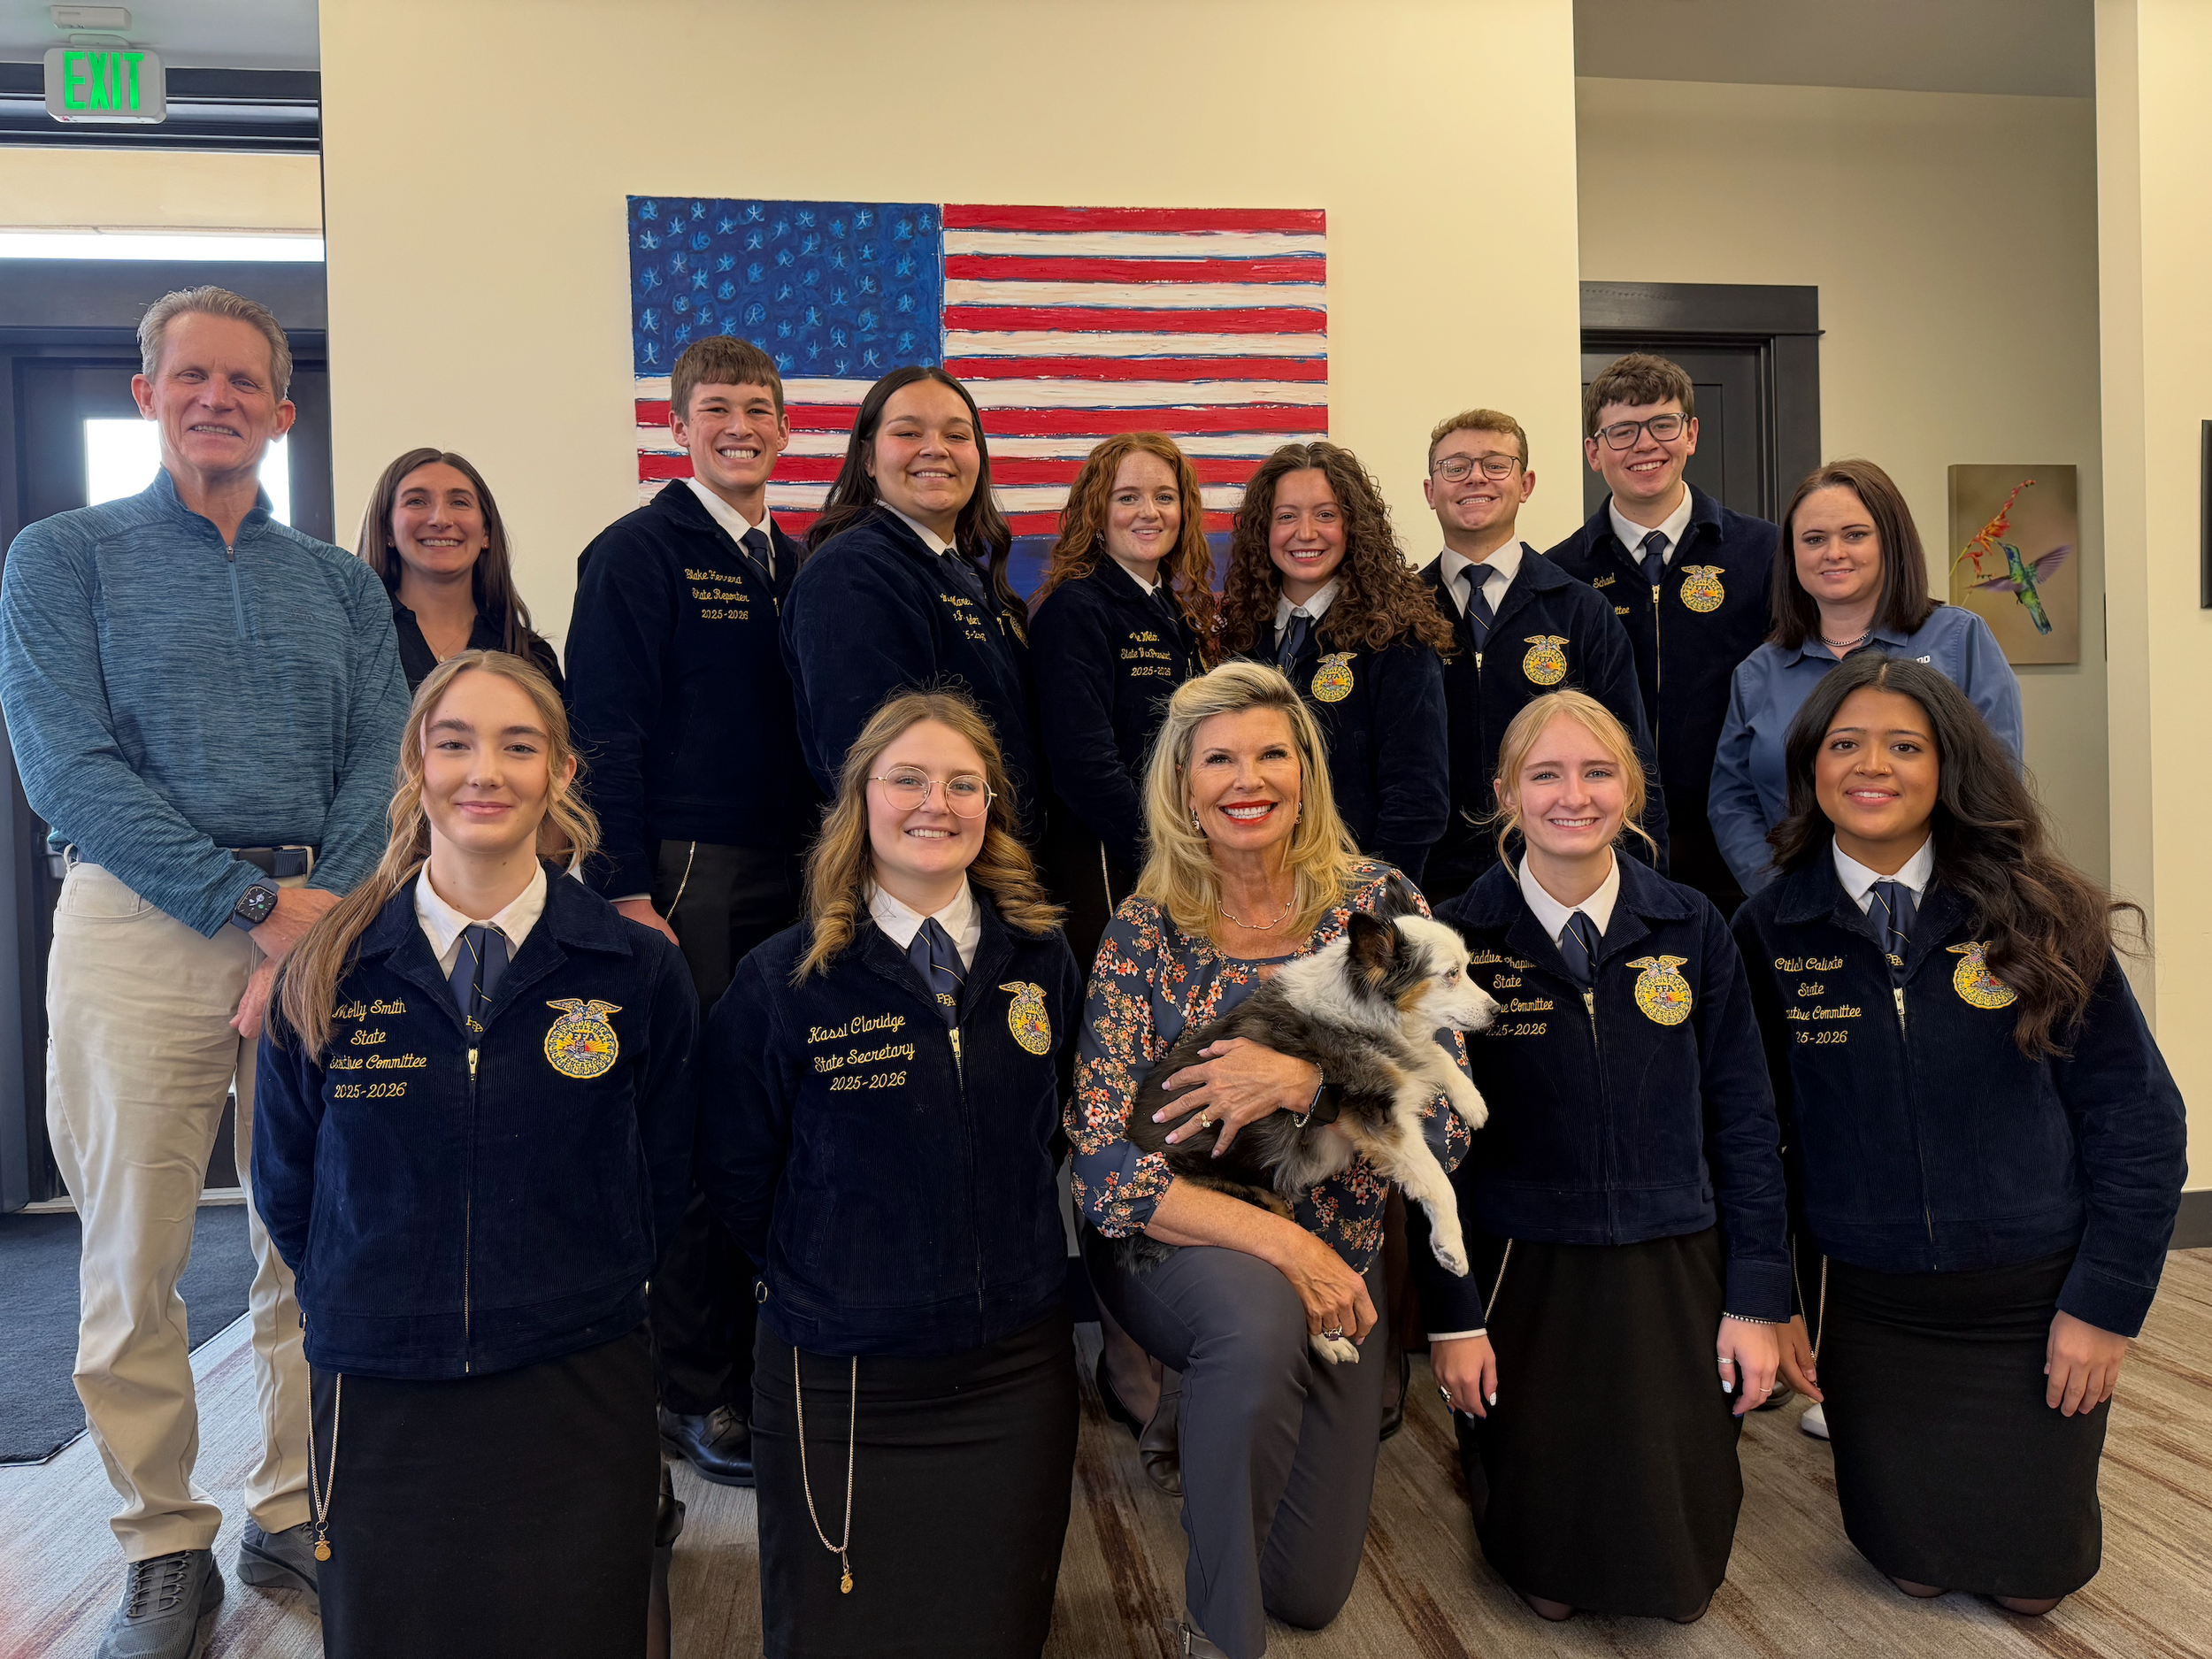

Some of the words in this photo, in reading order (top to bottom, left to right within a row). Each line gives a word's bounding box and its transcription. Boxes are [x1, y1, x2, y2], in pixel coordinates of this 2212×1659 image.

[64, 51, 144, 111] EXIT
[684, 568, 709, 580] Blake
[692, 587, 712, 600] State
[713, 588, 750, 604] Reporter
[701, 609, 749, 620] 2025-2026
[1120, 648, 1139, 660] State
[1493, 974, 1522, 989] State
[370, 997, 407, 1015] Smith
[935, 993, 956, 1007] FFA
[1509, 997, 1555, 1013] Committee
[1812, 1004, 1863, 1020] Committee
[807, 1023, 849, 1044] Kassi
[850, 1012, 906, 1033] Claridge
[350, 1028, 387, 1046] State
[572, 1033, 595, 1041] FFA
[365, 1053, 427, 1070] Committee
[813, 1054, 845, 1073] State
[847, 1042, 916, 1065] Secretary
[829, 1071, 907, 1091] 2025-2026
[334, 1081, 407, 1099] 2025-2026
